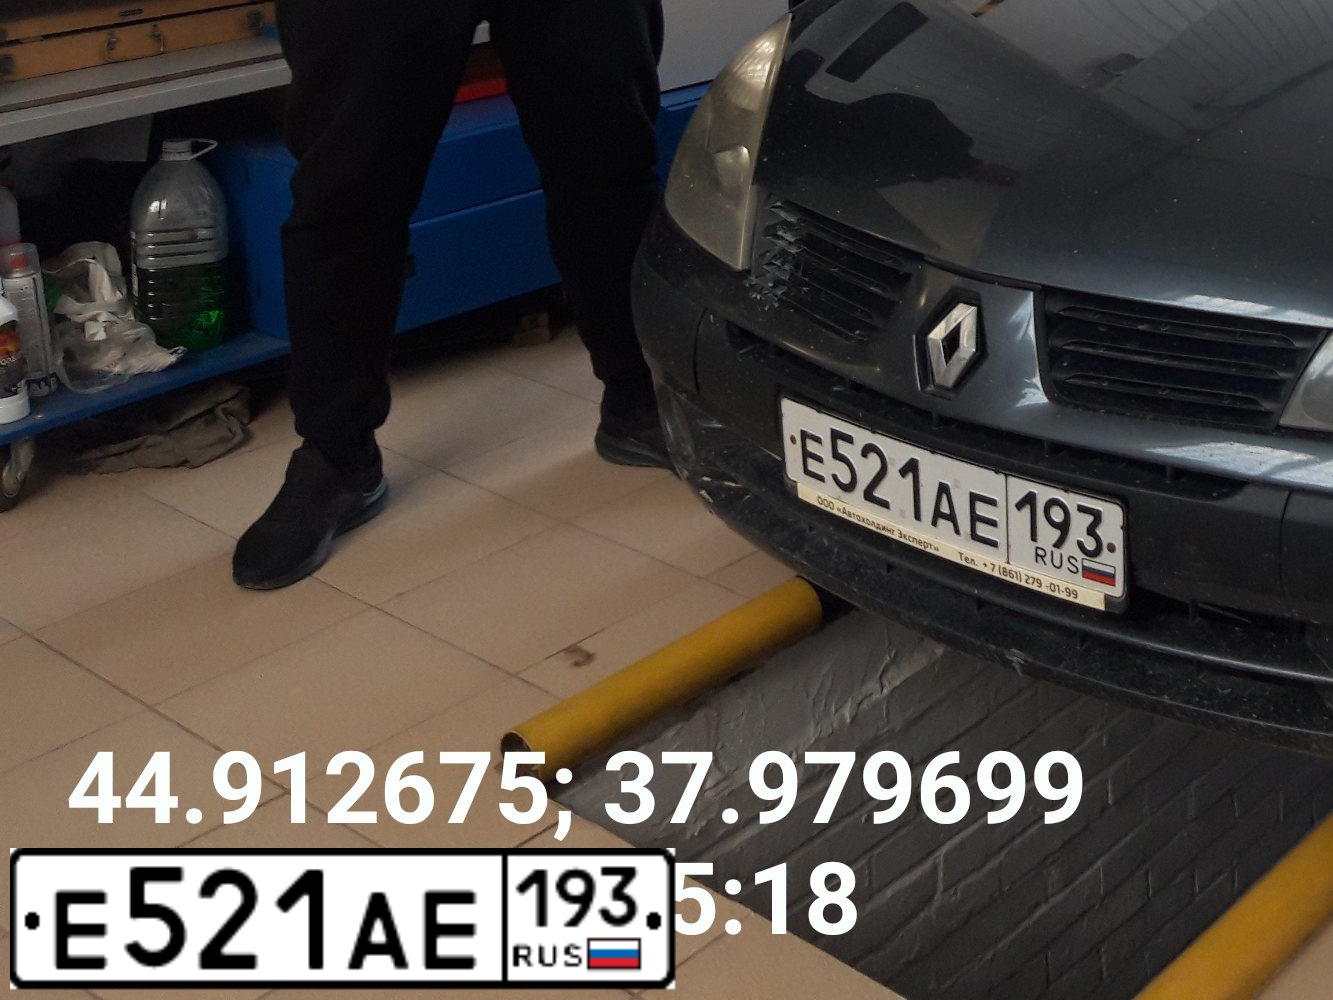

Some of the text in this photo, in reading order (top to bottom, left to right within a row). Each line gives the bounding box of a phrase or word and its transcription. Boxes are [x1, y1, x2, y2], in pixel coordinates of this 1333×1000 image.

[817, 495, 835, 510] ООО
[1015, 490, 1104, 558] 193
[958, 551, 979, 567] Тел.
[998, 565, 1023, 583] (861)
[1024, 573, 1043, 588] 279
[1034, 546, 1079, 575] RUS
